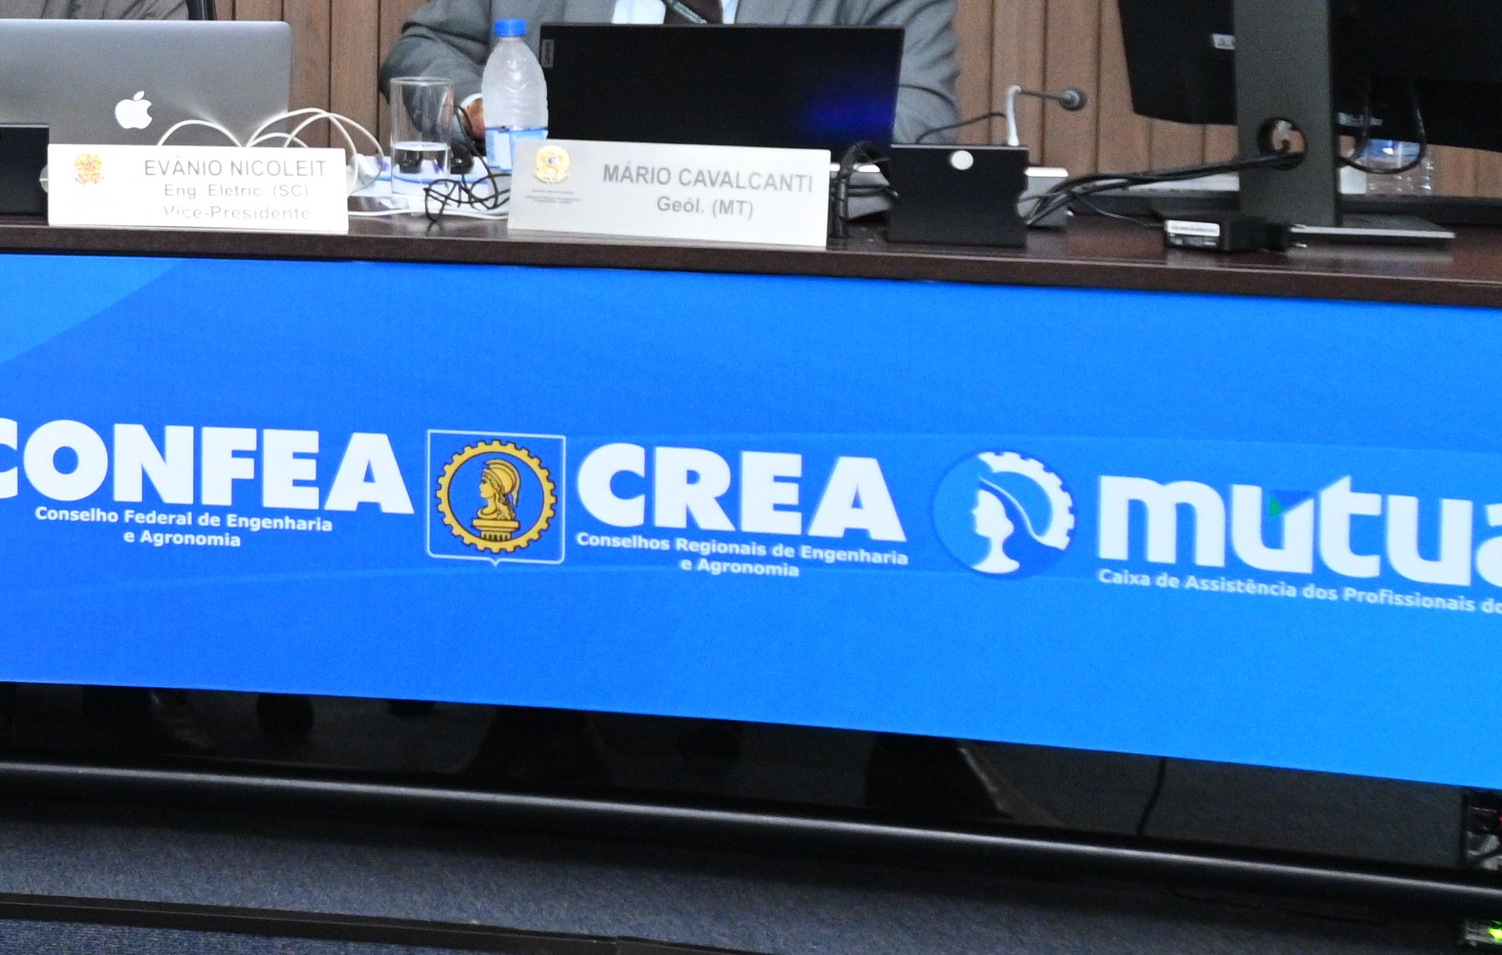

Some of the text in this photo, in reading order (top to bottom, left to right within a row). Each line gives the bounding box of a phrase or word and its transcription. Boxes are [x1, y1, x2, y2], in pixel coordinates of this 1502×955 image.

[144, 156, 327, 177] EVÂNIO NICOLEIT
[602, 160, 814, 194] MÁRIO CAVALCANTI
[272, 184, 309, 199] (SC)
[163, 205, 310, 221] Vice-Presidente
[656, 196, 754, 220] Geól. (MT)
[576, 442, 907, 542] CREA
[35, 506, 333, 533] Conselho Federal de Engenharia
[124, 530, 241, 547] e Agronomia
[577, 532, 908, 567] Conselhos Regionais de Engenharia
[681, 558, 800, 577] e Agronomia
[1099, 568, 1150, 587] Caixa
[1155, 572, 1180, 589] de
[1185, 575, 1296, 598] Assistência
[1302, 584, 1338, 601] dos
[1344, 586, 1475, 612] Profissionais
